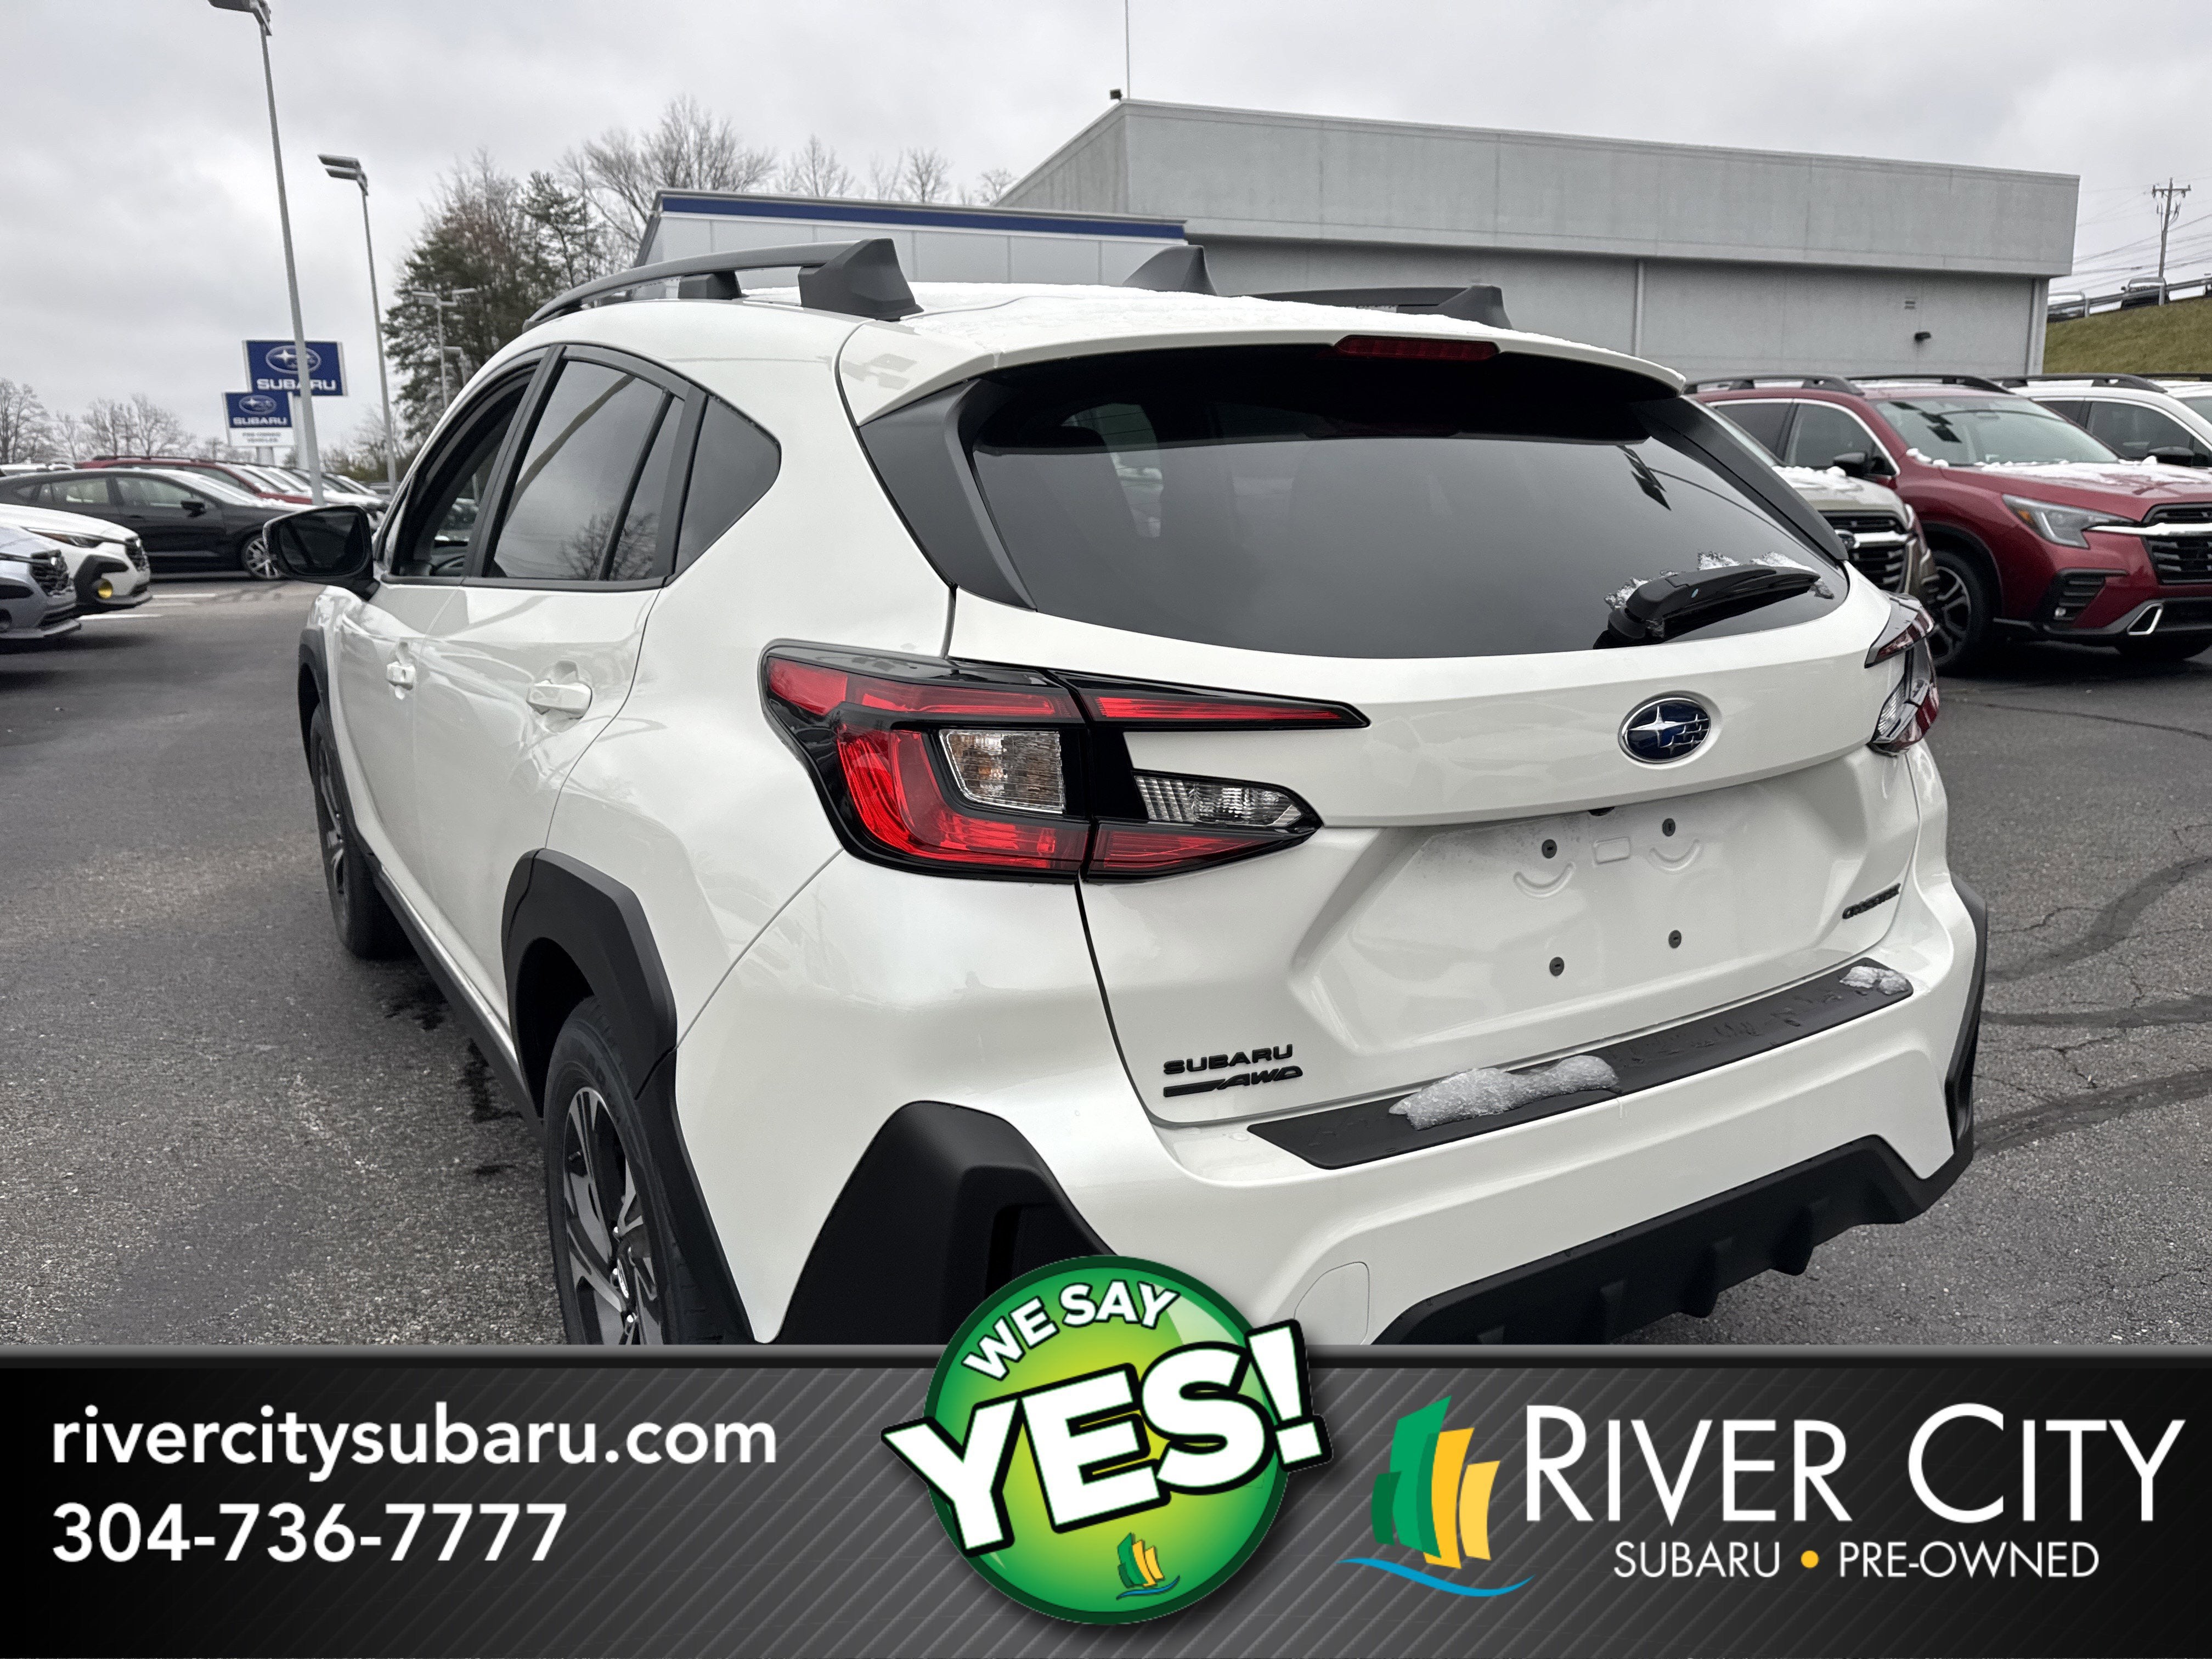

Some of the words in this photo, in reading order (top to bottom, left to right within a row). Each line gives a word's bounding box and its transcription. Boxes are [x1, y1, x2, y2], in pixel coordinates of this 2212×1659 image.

[257, 379, 337, 391] SUBRU
[233, 416, 287, 425] SUBARU
[1164, 1044, 1293, 1075] SUBARU
[1217, 1065, 1303, 1090] AWD
